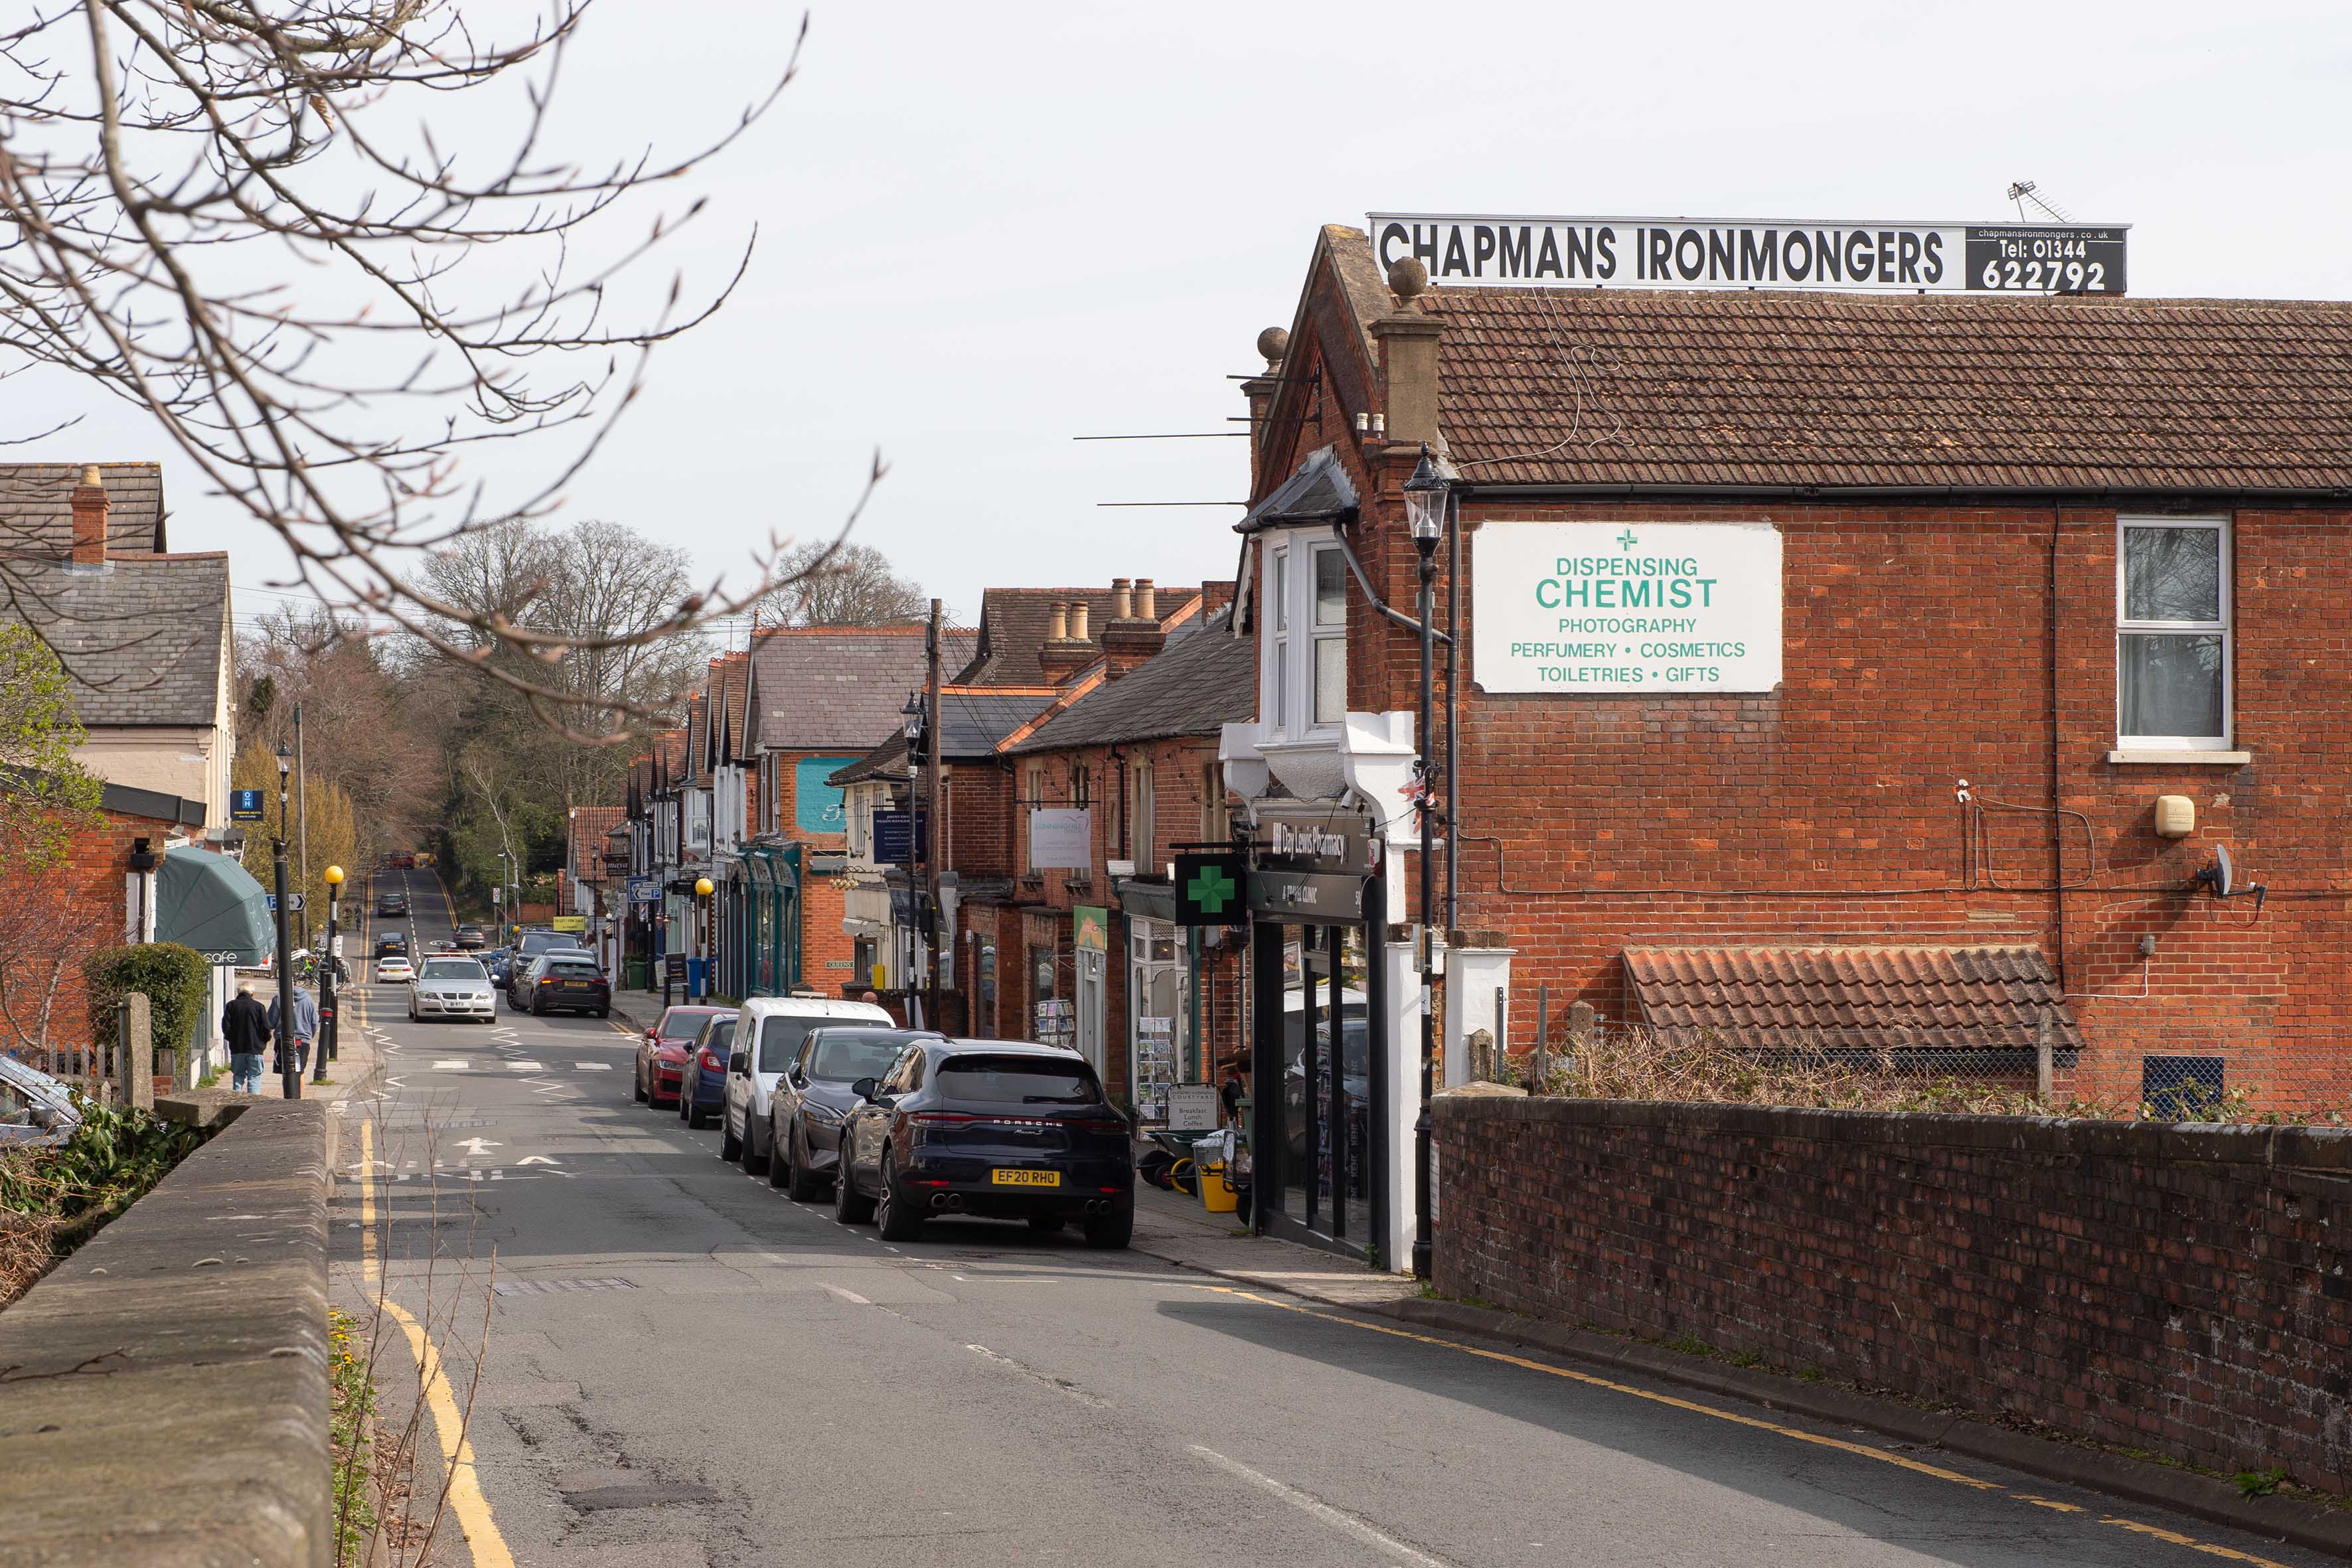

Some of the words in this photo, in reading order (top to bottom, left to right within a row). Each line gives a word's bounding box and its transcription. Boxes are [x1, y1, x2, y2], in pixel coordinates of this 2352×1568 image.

[1379, 222, 1616, 280] CHAPMANS
[1636, 228, 1943, 285] IRONMONGERS
[1999, 240, 2027, 258] Tel:
[2033, 240, 2086, 258] 01344
[1982, 260, 2105, 290] 622792
[1557, 558, 1698, 577] DISPENSING
[1535, 579, 1717, 609] CHEMIST
[1559, 618, 1697, 633] PHOTOGRAPHY
[1511, 643, 1617, 658] PERFUMERY
[1640, 642, 1745, 658] COSMETICS
[1537, 666, 1643, 682] TOILETRIES
[1666, 667, 1719, 682] GIFTS
[1282, 824, 1294, 861] Day
[1295, 824, 1312, 854] Lewis
[1312, 826, 1344, 865] Pharmacy
[998, 1171, 1029, 1182] EF20
[1032, 1172, 1055, 1184] RHO
